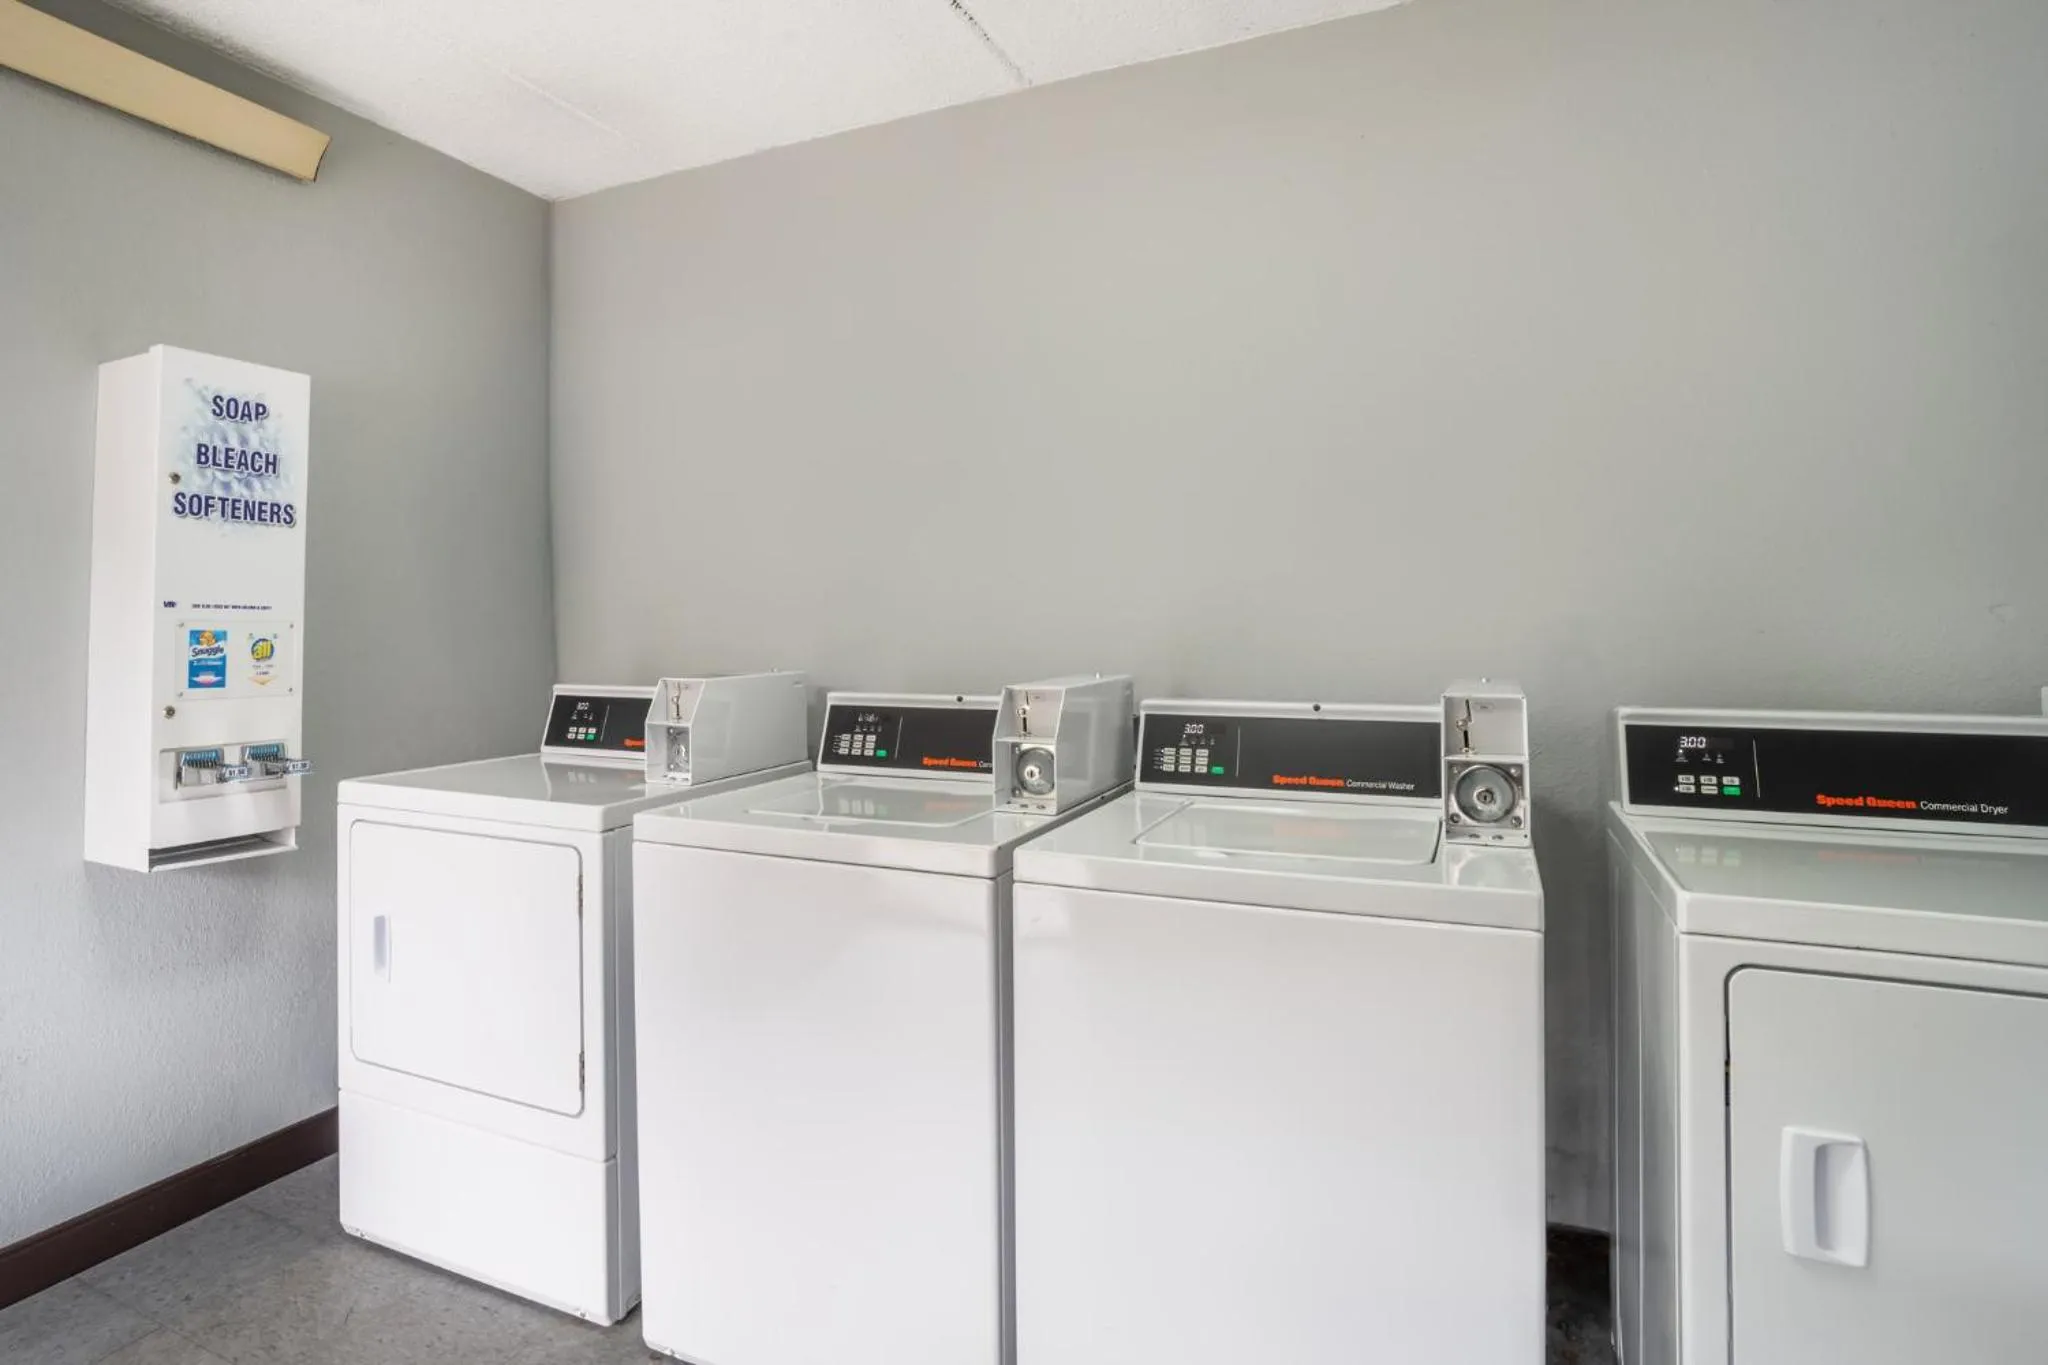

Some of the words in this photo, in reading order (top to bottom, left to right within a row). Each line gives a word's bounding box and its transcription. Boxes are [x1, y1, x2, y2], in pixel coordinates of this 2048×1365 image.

[211, 395, 268, 422] SOAP
[196, 443, 279, 475] BLEACH
[173, 491, 296, 525] SOFTENERS
[191, 645, 225, 658] Snuggle
[253, 639, 272, 660] all
[1272, 774, 1307, 785] Speed
[1309, 775, 1344, 788] Queen
[1346, 778, 1387, 789] Commercial
[1388, 780, 1415, 791] Washer
[1815, 793, 1864, 807] Speed
[1866, 796, 1917, 809] Queen
[1920, 800, 1978, 813] Commercial
[1981, 804, 2009, 815] Dryer
